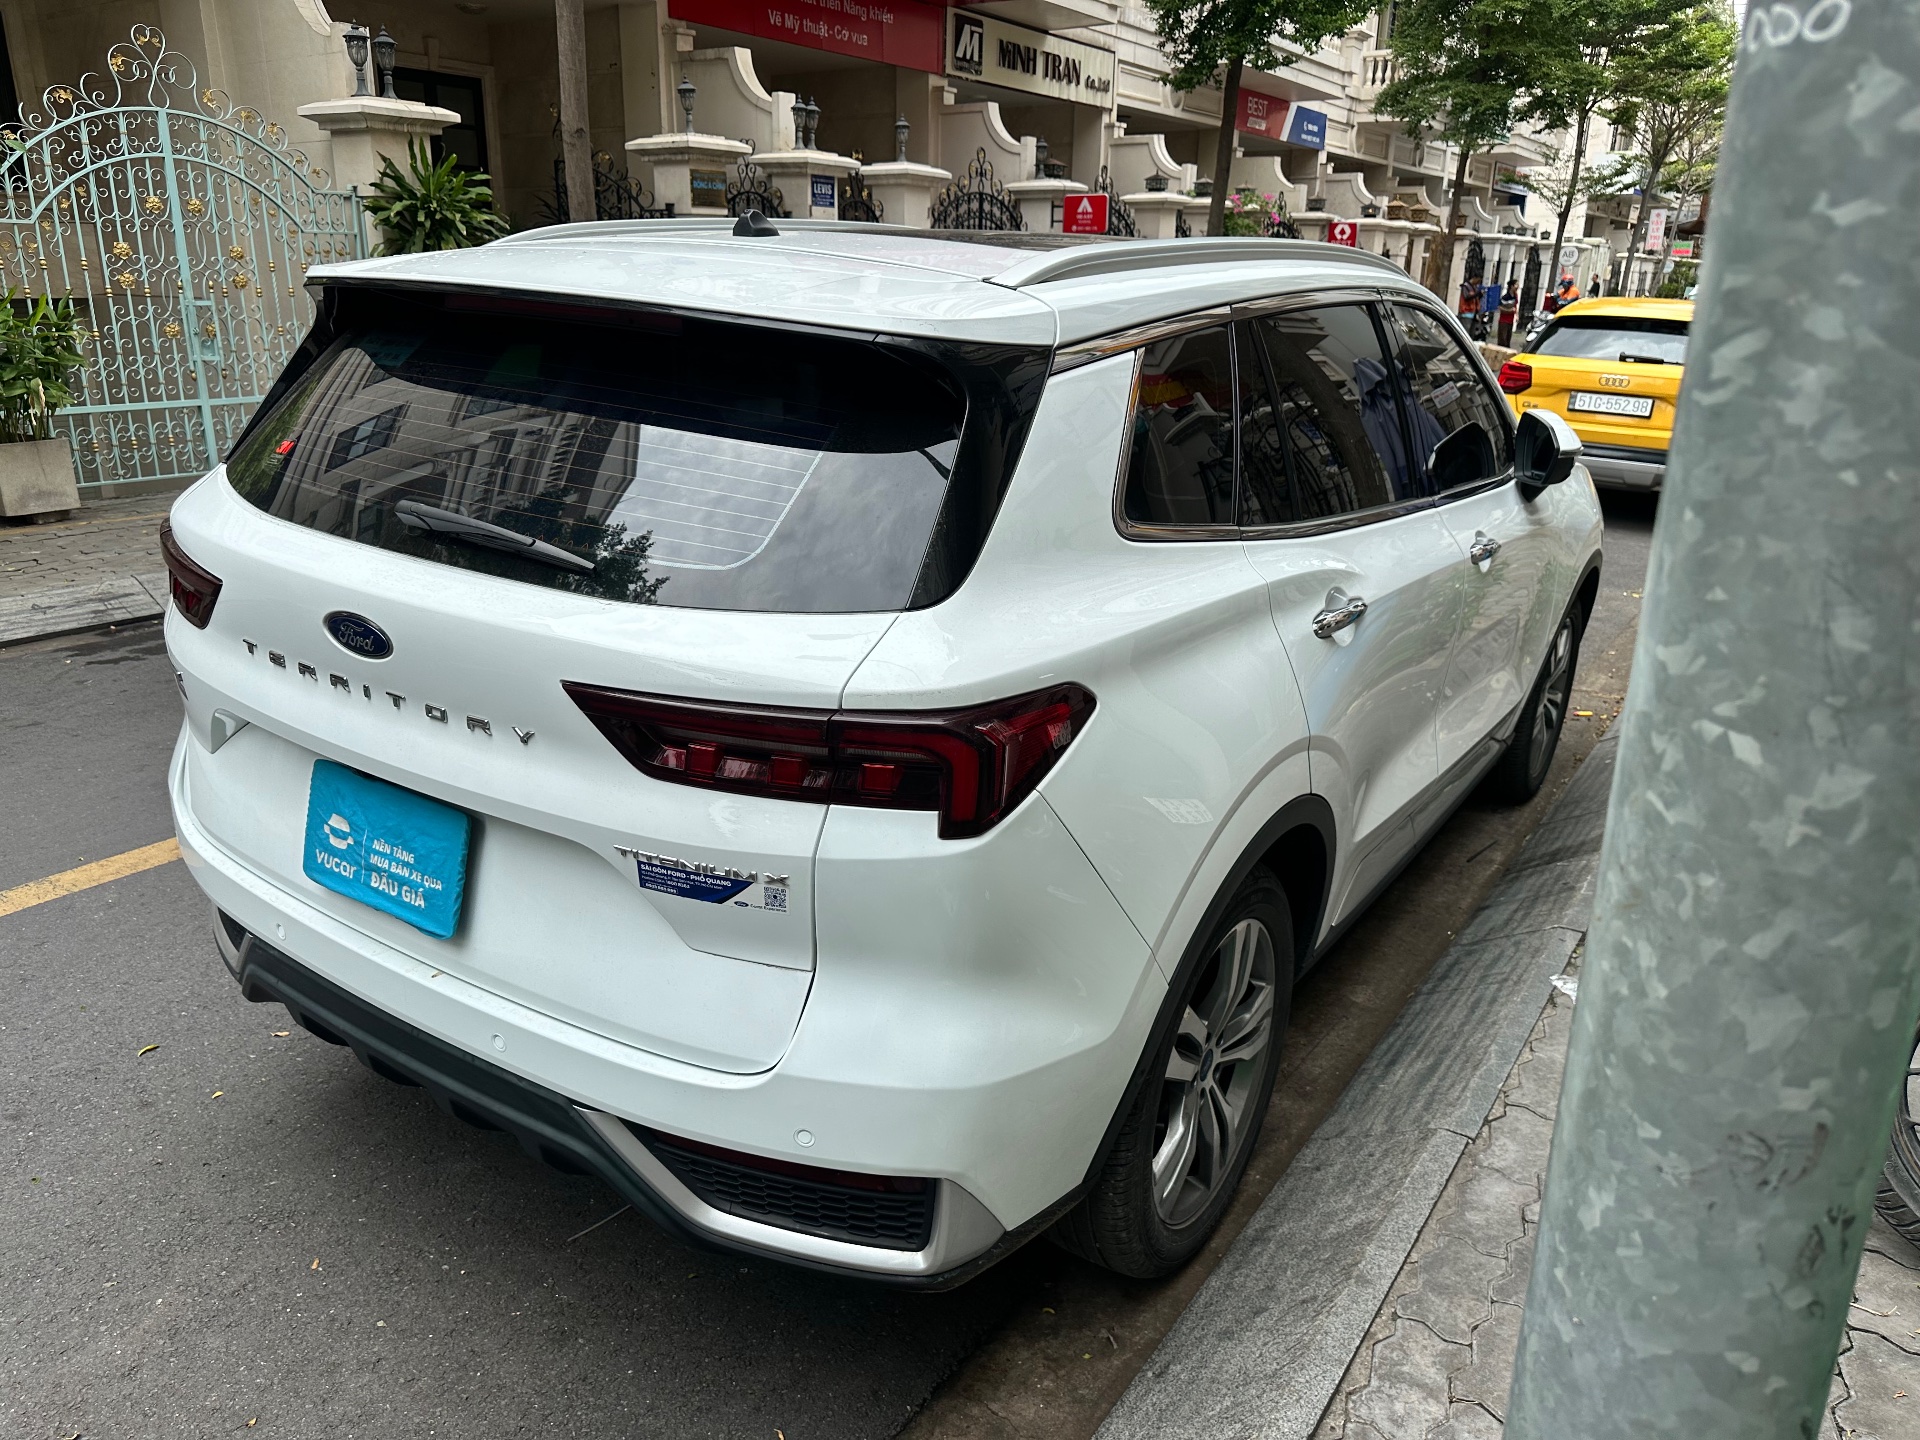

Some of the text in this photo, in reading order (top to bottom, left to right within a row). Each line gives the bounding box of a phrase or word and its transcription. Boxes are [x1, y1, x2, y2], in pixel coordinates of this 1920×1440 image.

[768, 9, 782, 27] Vẽ
[785, 13, 800, 34] Mỹ
[803, 18, 828, 39] thuật
[851, 31, 868, 46] vua
[869, 5, 894, 24] khiếu
[998, 38, 1037, 76] MINH
[1041, 50, 1081, 86] TRAN
[1247, 96, 1268, 117] BEST
[1578, 395, 1649, 413] 51G-552.98
[337, 621, 375, 652] Ford
[242, 638, 535, 745] TERRITORY
[315, 848, 357, 879] vucar
[372, 838, 415, 864] NỀN TẢNG
[613, 844, 790, 887] TITANIUM X
[370, 853, 443, 891] MUA BÁN XE QUA
[640, 863, 652, 871] SÀI
[652, 866, 667, 875] GÒN
[667, 869, 686, 879] FORD
[705, 877, 732, 887] QUANG
[401, 888, 425, 909] GIÁ
